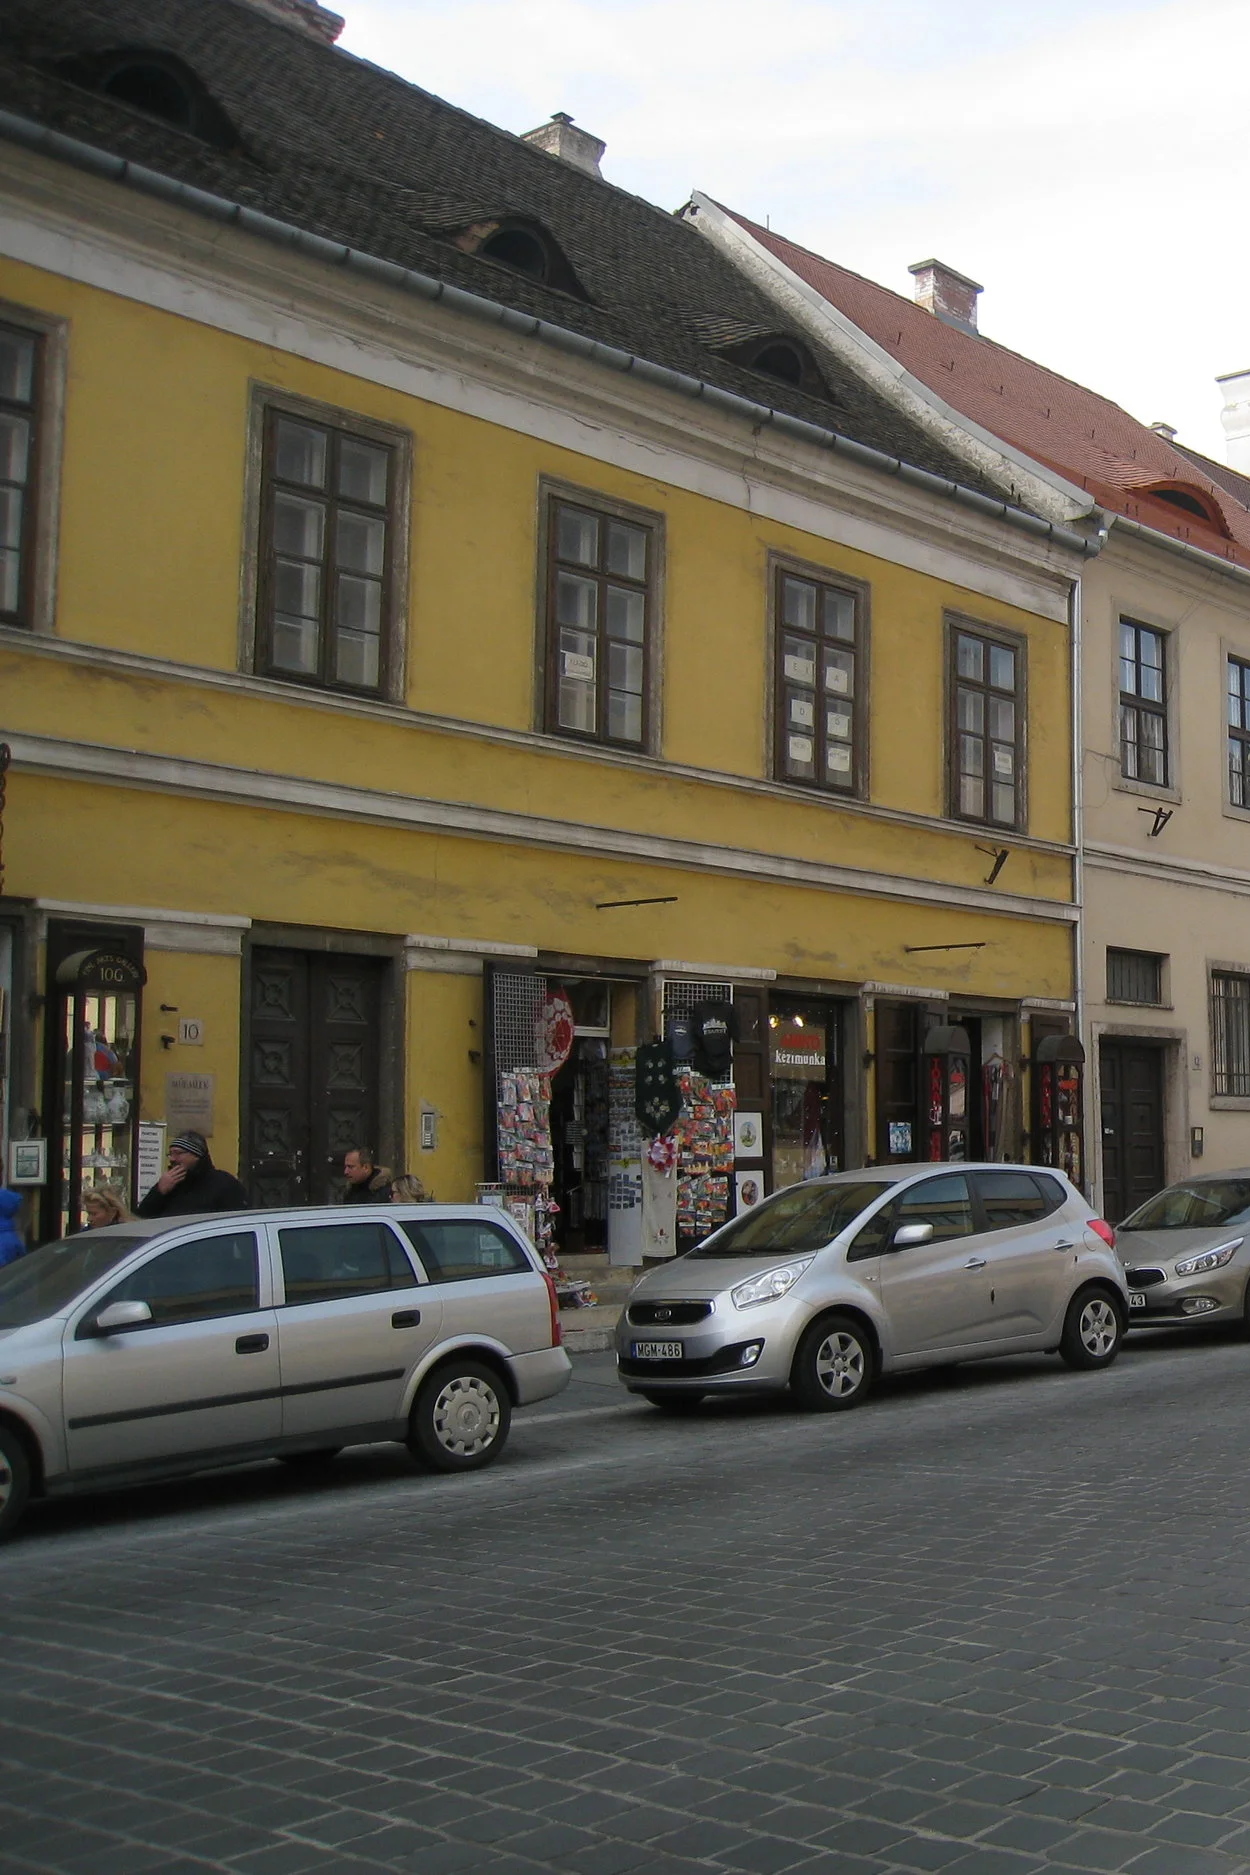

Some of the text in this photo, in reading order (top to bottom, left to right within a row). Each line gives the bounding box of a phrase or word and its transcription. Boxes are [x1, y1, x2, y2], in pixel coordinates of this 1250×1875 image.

[183, 1023, 199, 1040] 10
[775, 1050, 826, 1066] kézimunka
[637, 1344, 681, 1357] MGM-486
